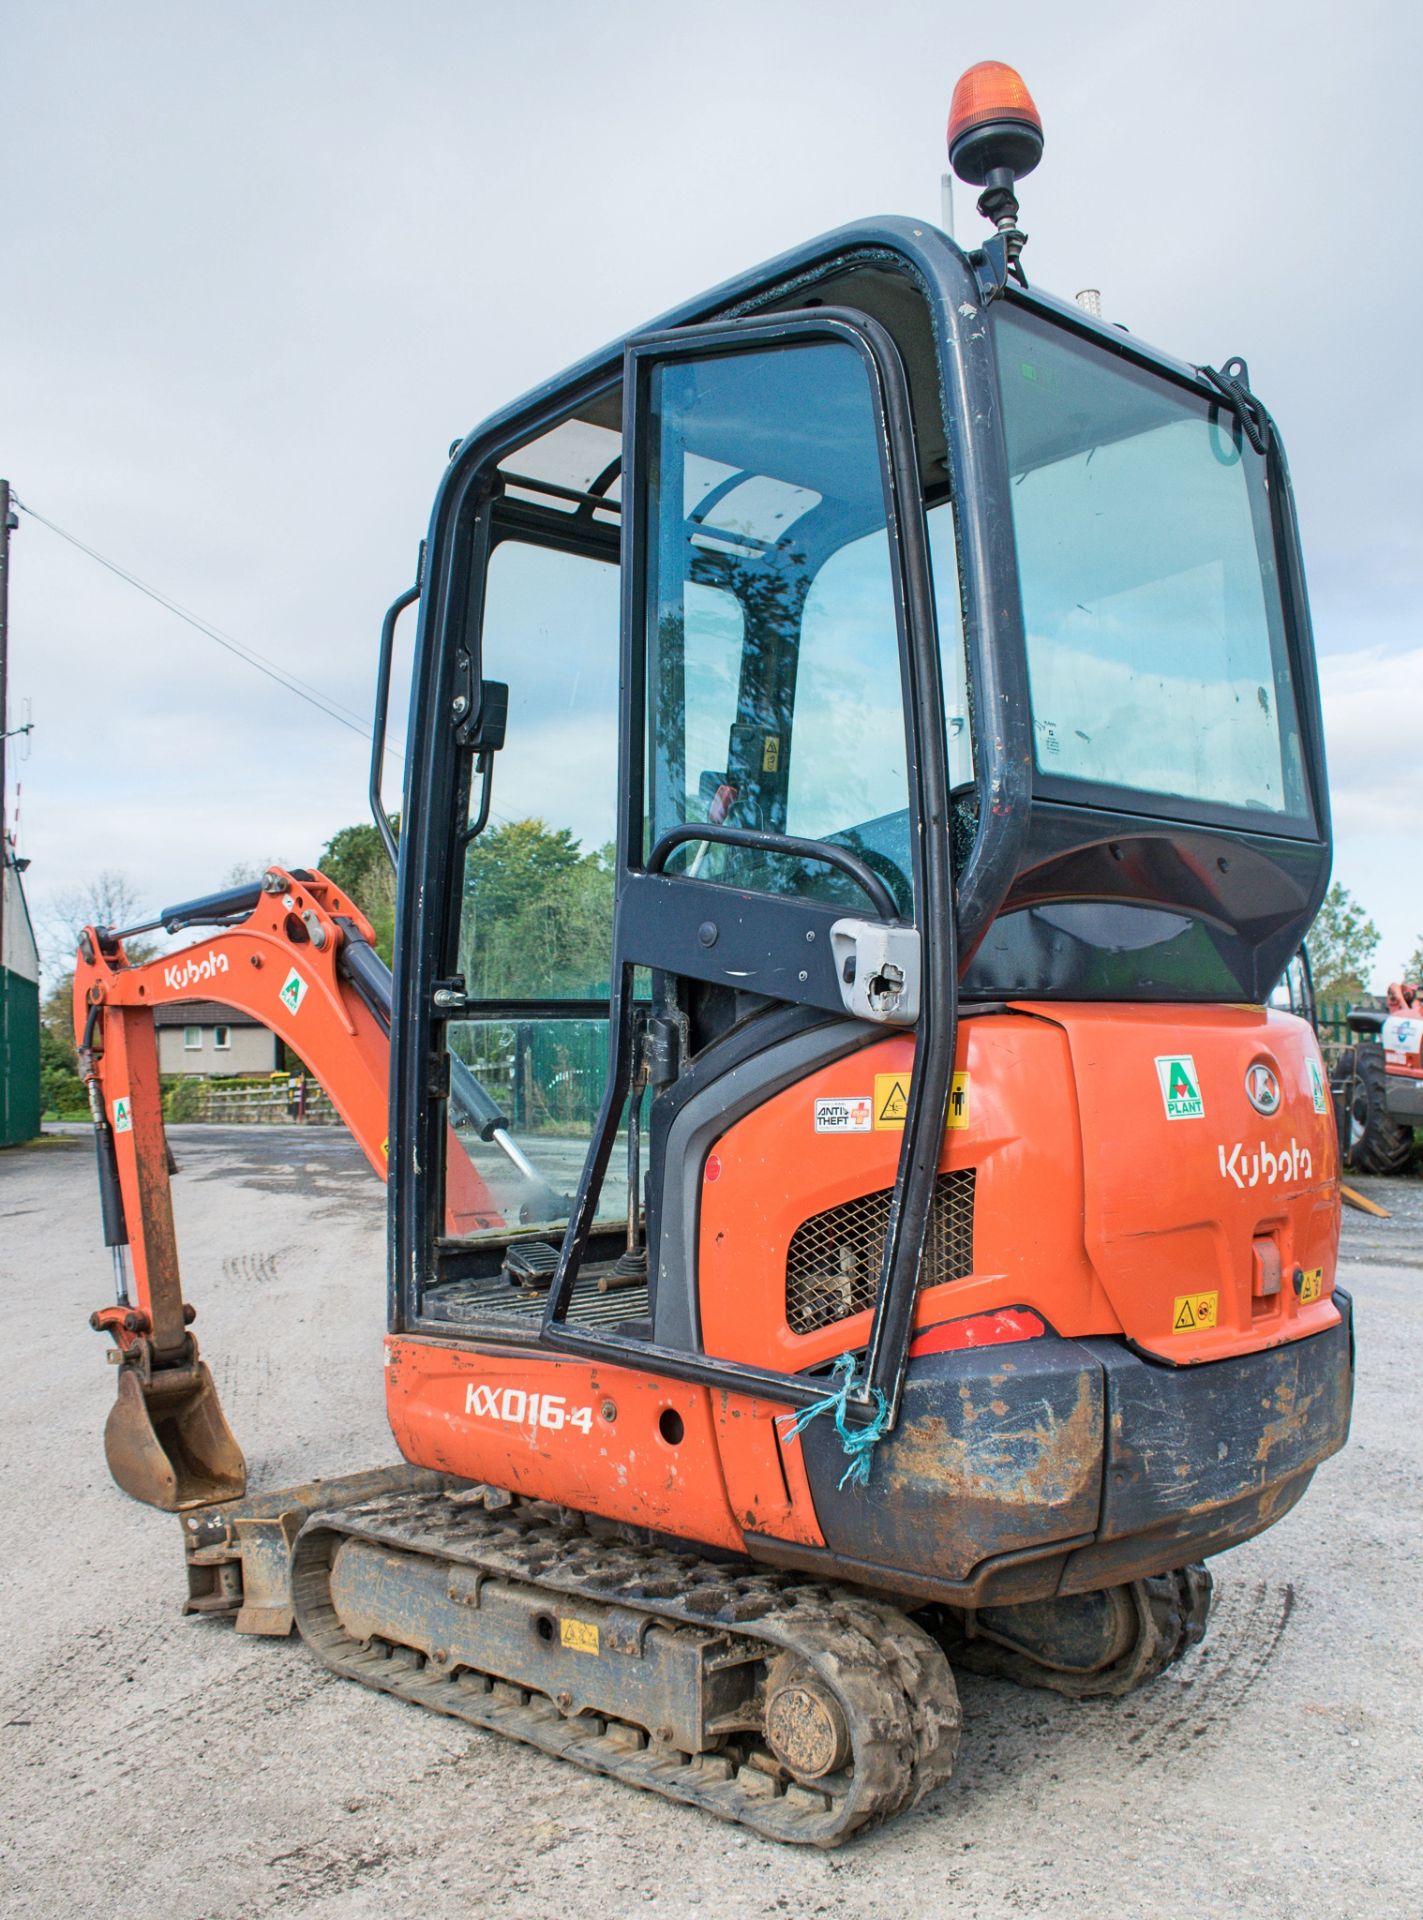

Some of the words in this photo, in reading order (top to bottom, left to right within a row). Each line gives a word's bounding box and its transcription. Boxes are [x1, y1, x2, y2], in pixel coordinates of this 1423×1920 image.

[164, 950, 229, 990] Kubota
[1168, 1062, 1198, 1100] A
[817, 1106, 843, 1116] ANTI
[817, 1116, 849, 1126] THEFT
[1168, 1101, 1202, 1115] PLANT
[1217, 1137, 1313, 1189] Kubota
